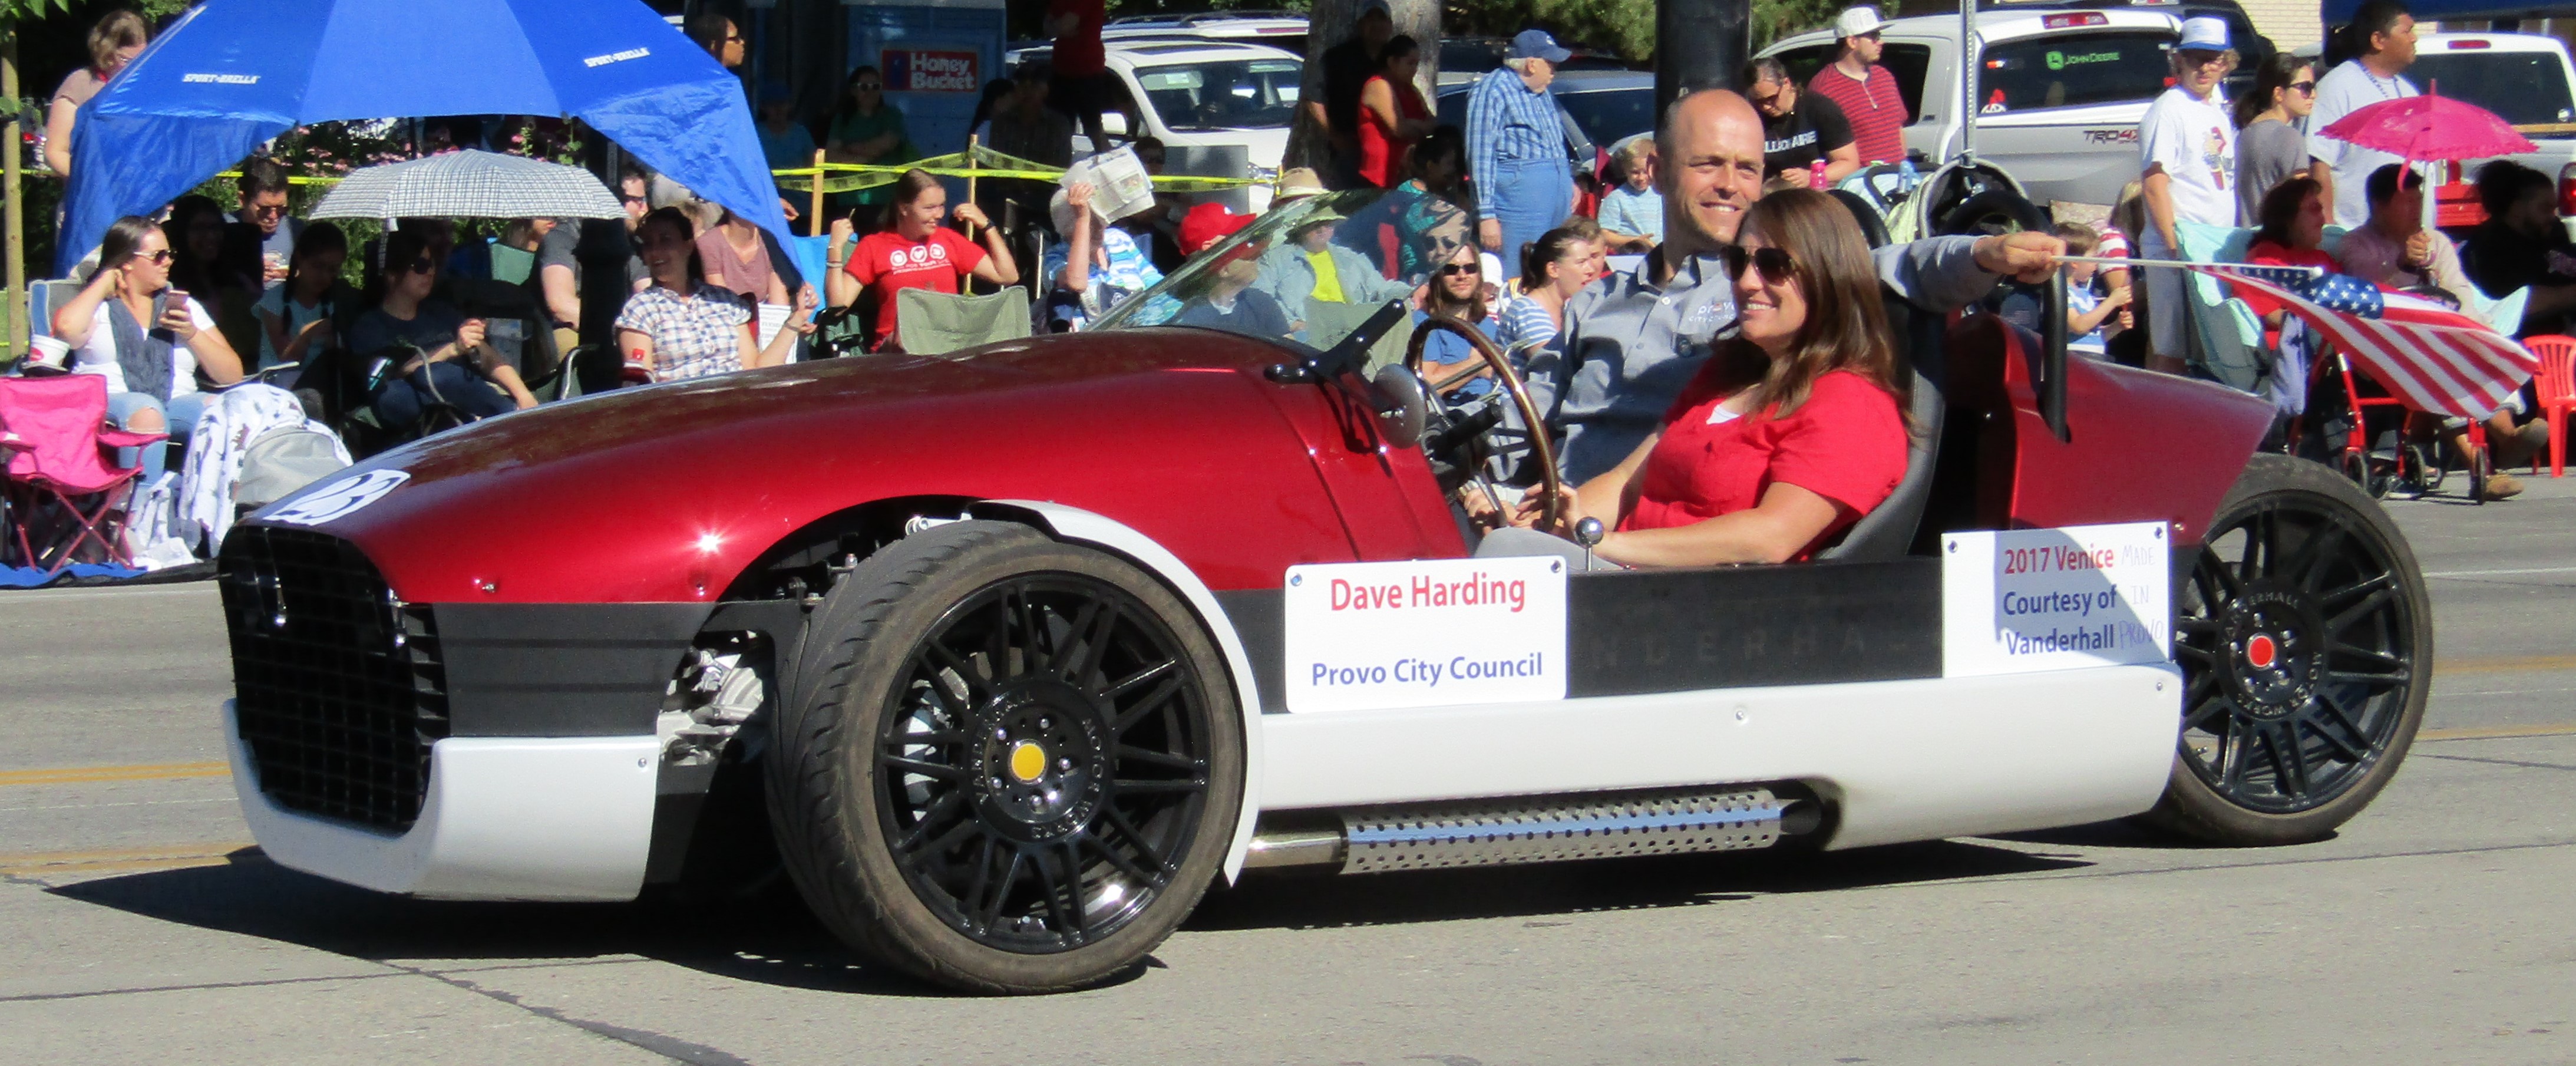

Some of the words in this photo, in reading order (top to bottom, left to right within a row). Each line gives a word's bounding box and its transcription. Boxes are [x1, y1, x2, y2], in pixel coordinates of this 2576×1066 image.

[910, 52, 970, 75] Honey
[910, 71, 975, 88] Bucket
[2004, 547, 2050, 575] 2017
[2055, 543, 2115, 570] Venice
[2122, 545, 2155, 566] MADE
[1330, 578, 1403, 611] Dave
[1411, 572, 1525, 612] Harding
[2003, 591, 2093, 616] Courtesy
[2098, 583, 2117, 609] of
[2130, 585, 2149, 605] IN
[2006, 623, 2114, 655] Vanderhall
[1312, 662, 1387, 686] Provo
[1393, 658, 1443, 687] City
[1450, 652, 1543, 679] Council
